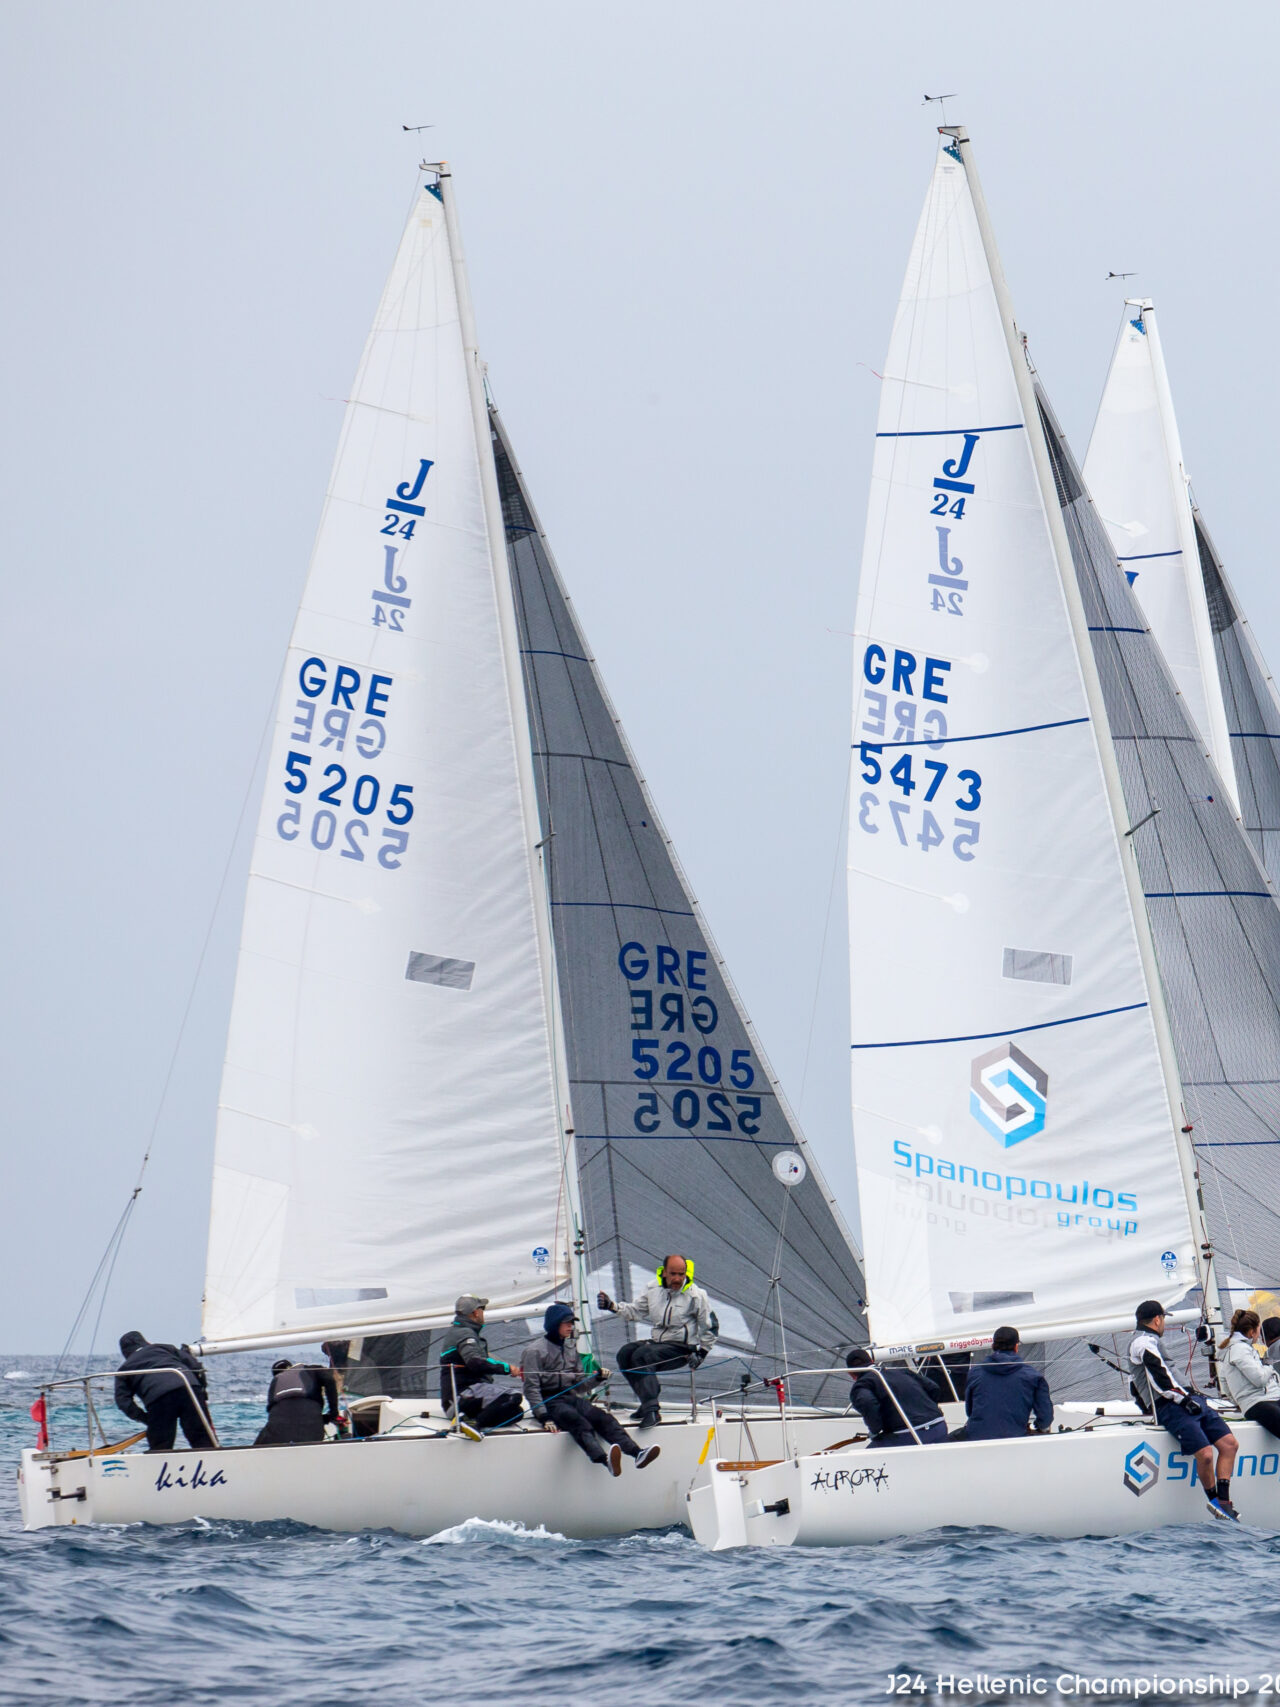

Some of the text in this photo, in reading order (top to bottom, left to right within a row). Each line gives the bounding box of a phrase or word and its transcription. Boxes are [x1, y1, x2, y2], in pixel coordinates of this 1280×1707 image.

[396, 458, 434, 501] J
[942, 434, 980, 479] J
[380, 513, 415, 540] 24
[930, 493, 966, 520] 24
[298, 657, 393, 718] GRE
[863, 644, 952, 704] GRE
[283, 750, 414, 826] 5205
[860, 741, 982, 812] 5473
[618, 941, 708, 991] GRE
[632, 1038, 755, 1089] 5205
[893, 1140, 1138, 1212] Spanopoulos
[1057, 1211, 1138, 1236] group
[155, 1460, 228, 1491] kika
[811, 1462, 889, 1494] AURORA
